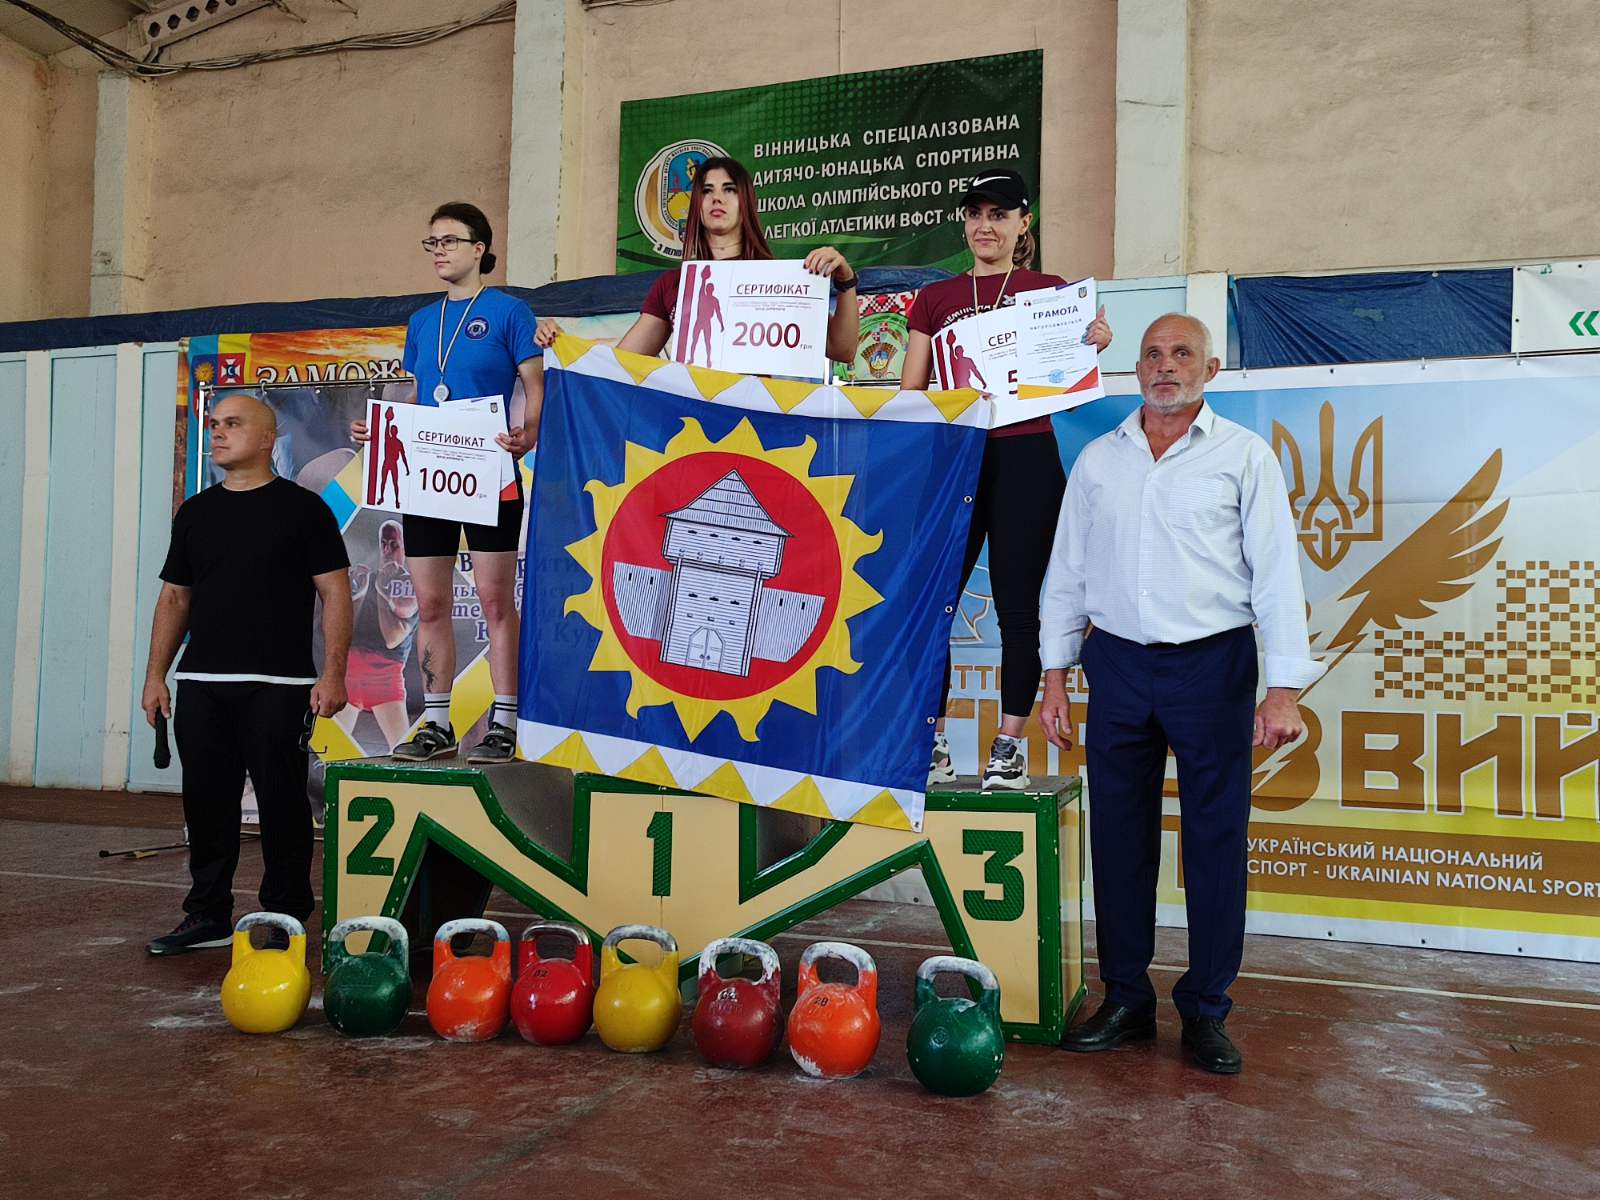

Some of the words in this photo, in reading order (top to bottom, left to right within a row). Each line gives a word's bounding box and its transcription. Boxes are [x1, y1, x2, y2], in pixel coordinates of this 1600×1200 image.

[754, 132, 851, 158] ВІННИЦЬКА
[863, 113, 1020, 146] СПЕЦІАЛІЗОВАНА
[753, 155, 904, 187] ДИТЯЧО-ЮНАЦЬКА
[916, 143, 1020, 168] СПОРТИВНА
[757, 194, 806, 213] ШКОЛА
[811, 180, 942, 208] ОЛІМПІЙСЬКОГО
[764, 220, 817, 239] ЛЕГКОЇ
[820, 213, 899, 236] АТЛЕТИКИ
[900, 209, 943, 227] ВФСТ
[736, 283, 811, 296] СЕРТИФІКАТ
[1033, 305, 1079, 320] ГРАМОТА
[732, 321, 801, 349] 2000
[256, 359, 415, 385] ЗАМОЖ
[417, 430, 486, 448] СЕРТИФІКАТ
[419, 467, 477, 497] 1000
[346, 797, 395, 876] 2
[646, 811, 673, 897] 1
[1247, 837, 1376, 860] УКРАЇНСЬКИЙ
[1382, 845, 1544, 871] НАЦІОНАЛЬНИЙ
[962, 829, 1025, 921] 3
[1247, 859, 1308, 877] СПОРТ
[1326, 864, 1430, 886] UKRAINIAN
[1436, 871, 1537, 894] NATIONAL
[1542, 878, 1600, 899] SPORT
